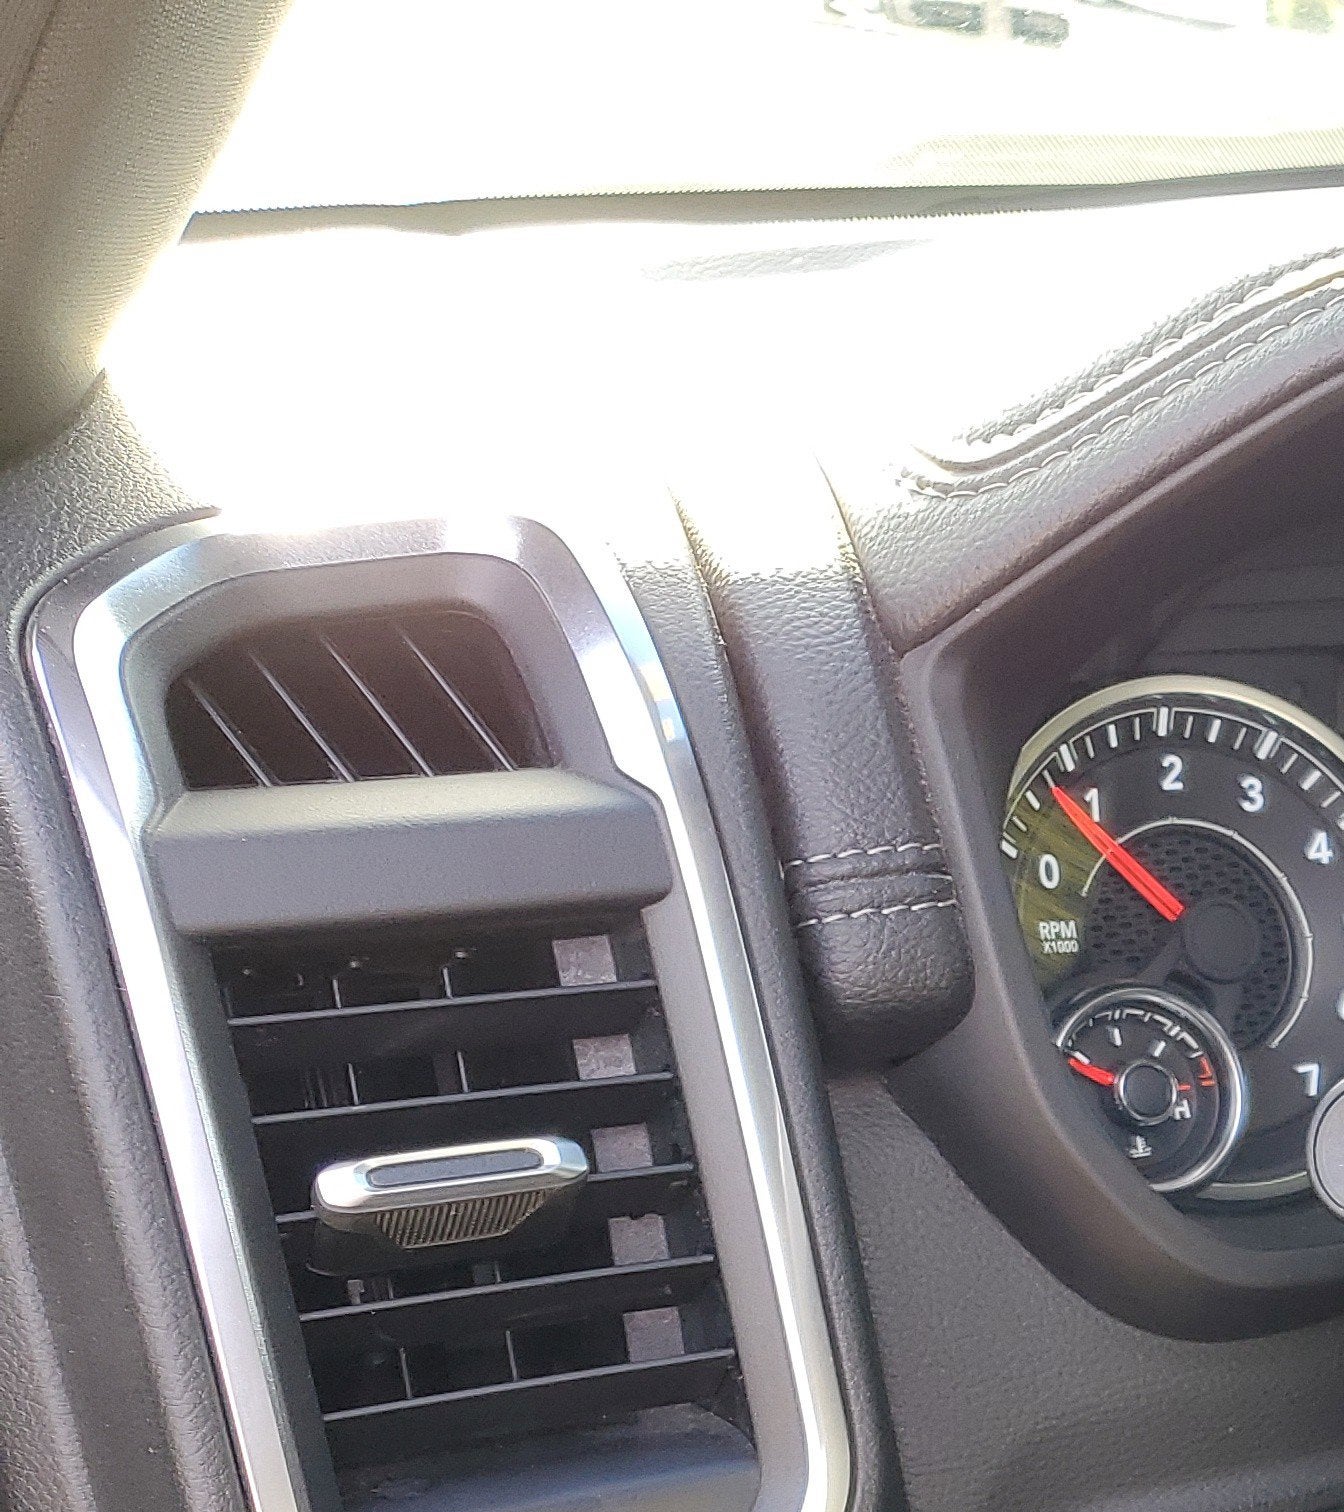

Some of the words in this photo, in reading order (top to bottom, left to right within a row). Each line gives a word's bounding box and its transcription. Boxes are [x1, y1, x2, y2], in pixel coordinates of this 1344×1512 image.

[1160, 753, 1185, 792] 2
[1083, 786, 1101, 824] 1
[1238, 775, 1266, 813] 3
[1306, 831, 1334, 865] 4
[1038, 853, 1061, 890] 0
[1039, 920, 1078, 940] RPM
[1292, 1062, 1320, 1097] 7
